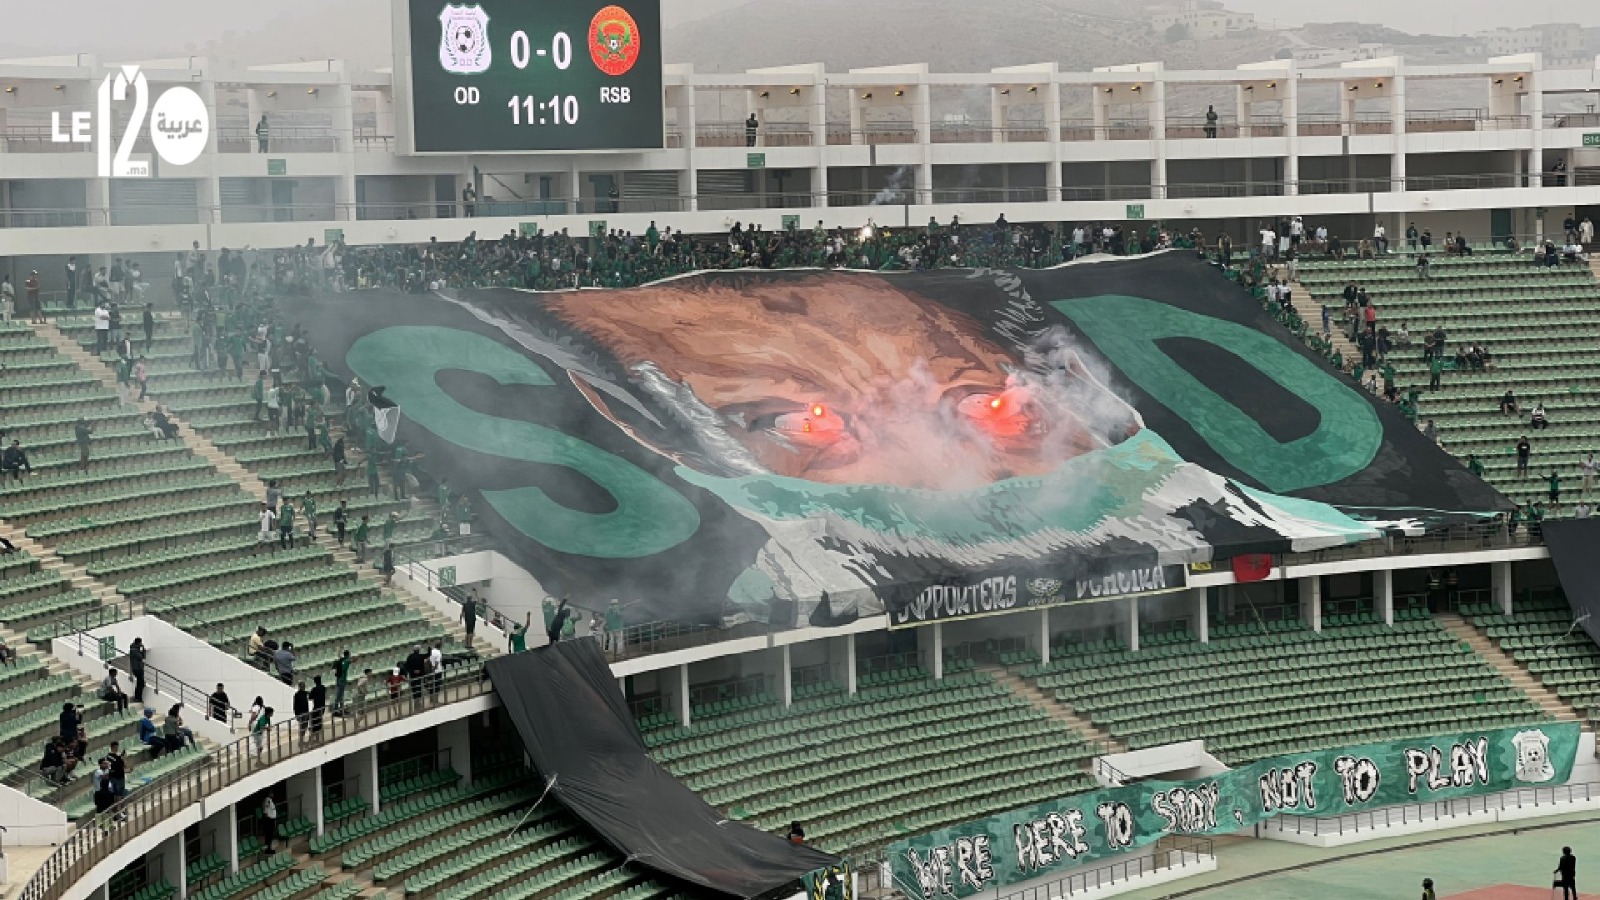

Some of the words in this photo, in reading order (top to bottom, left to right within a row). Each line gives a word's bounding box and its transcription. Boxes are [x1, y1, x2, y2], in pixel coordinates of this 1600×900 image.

[454, 87, 480, 104] OD
[600, 87, 631, 103] RSB
[508, 95, 579, 125] 11:10
[1013, 808, 1090, 875] HERE
[1095, 800, 1135, 850] TO
[1151, 780, 1220, 833] STAY
[1258, 761, 1317, 813] NOT
[1334, 756, 1381, 807] TO
[1403, 735, 1489, 794] PLAY
